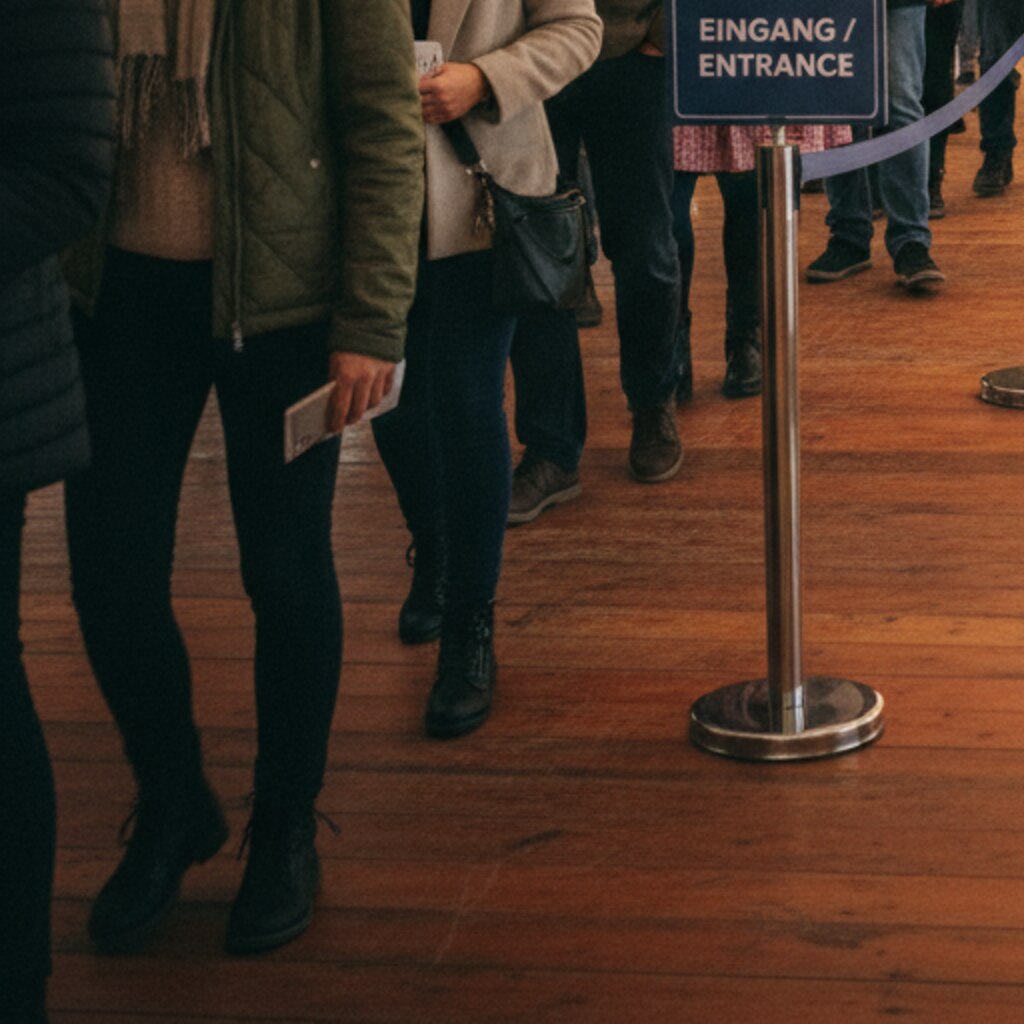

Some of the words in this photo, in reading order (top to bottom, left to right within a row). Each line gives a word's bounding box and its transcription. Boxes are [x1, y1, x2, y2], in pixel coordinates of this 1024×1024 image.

[699, 17, 837, 43] EINGANG
[842, 17, 858, 44] /
[699, 52, 855, 77] ENTRANCE
